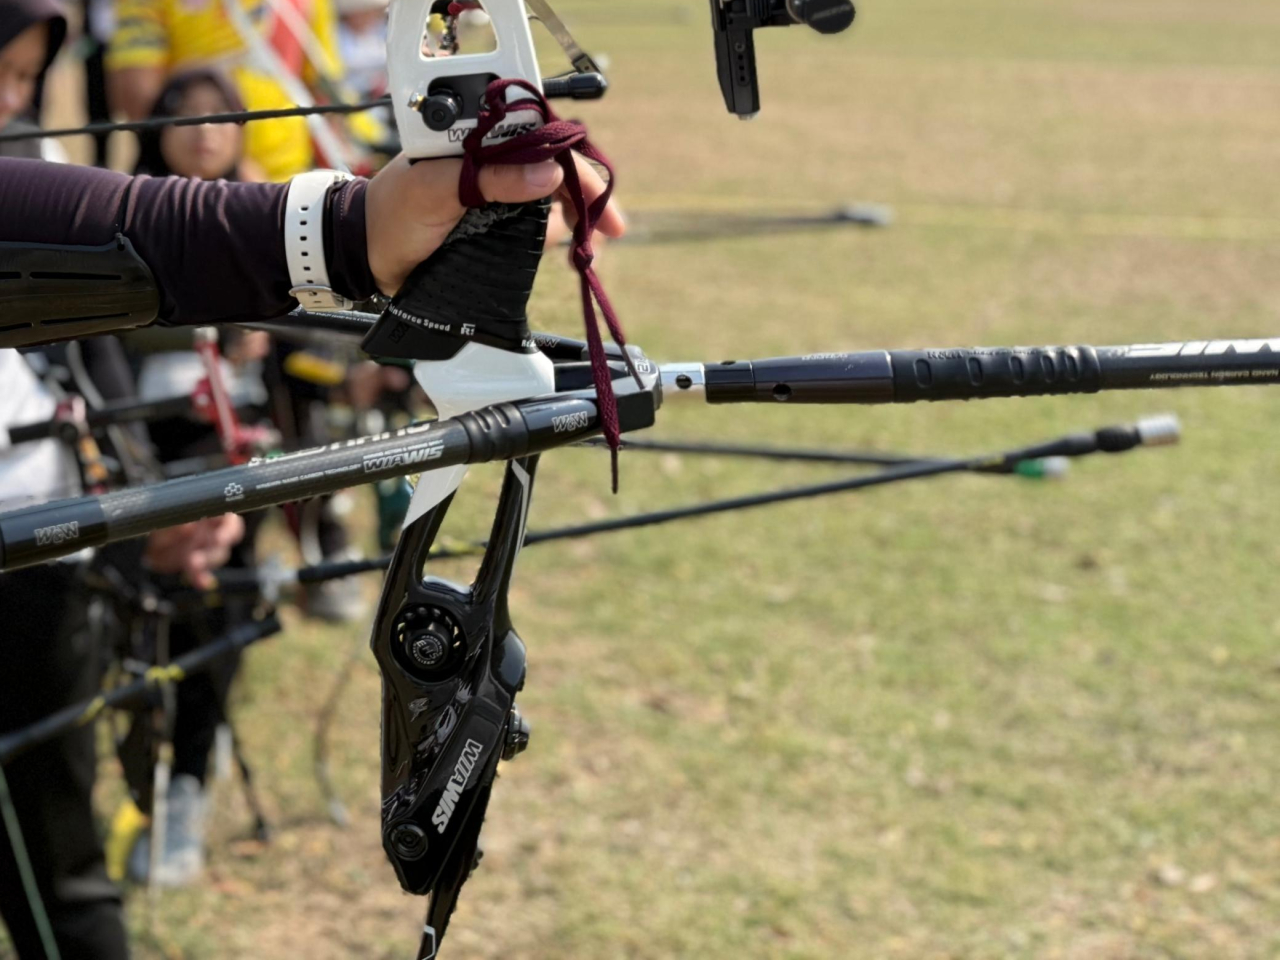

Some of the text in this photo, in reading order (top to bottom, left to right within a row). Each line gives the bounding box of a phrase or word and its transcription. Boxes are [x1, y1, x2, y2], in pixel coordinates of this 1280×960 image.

[423, 318, 451, 332] Speed
[363, 445, 445, 472] WIAWIS
[431, 738, 483, 834] WIAWIS
